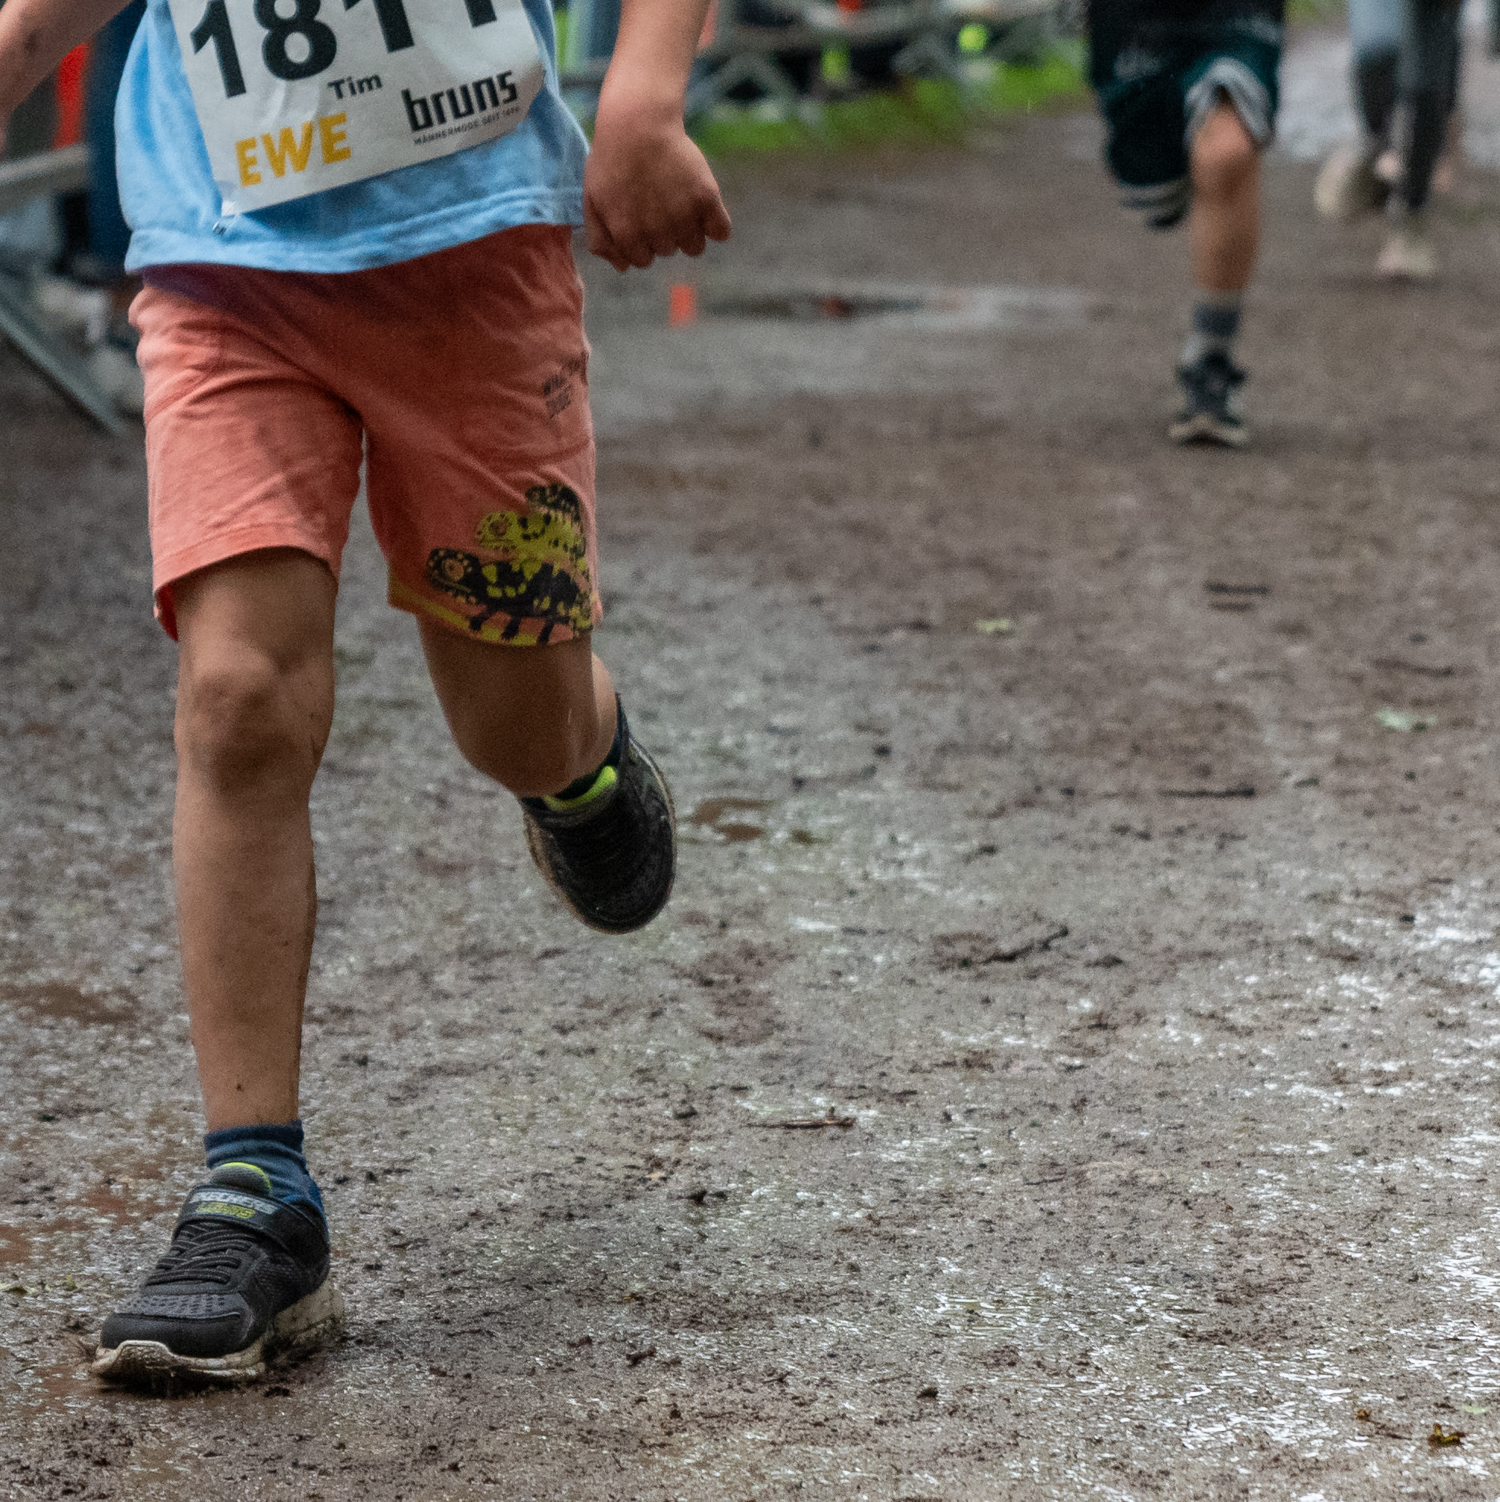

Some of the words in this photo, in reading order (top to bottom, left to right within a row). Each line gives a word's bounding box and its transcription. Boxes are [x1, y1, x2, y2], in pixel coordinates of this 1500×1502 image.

[327, 73, 383, 100] Tim
[401, 69, 518, 132] bruns
[235, 111, 352, 187] EWE
